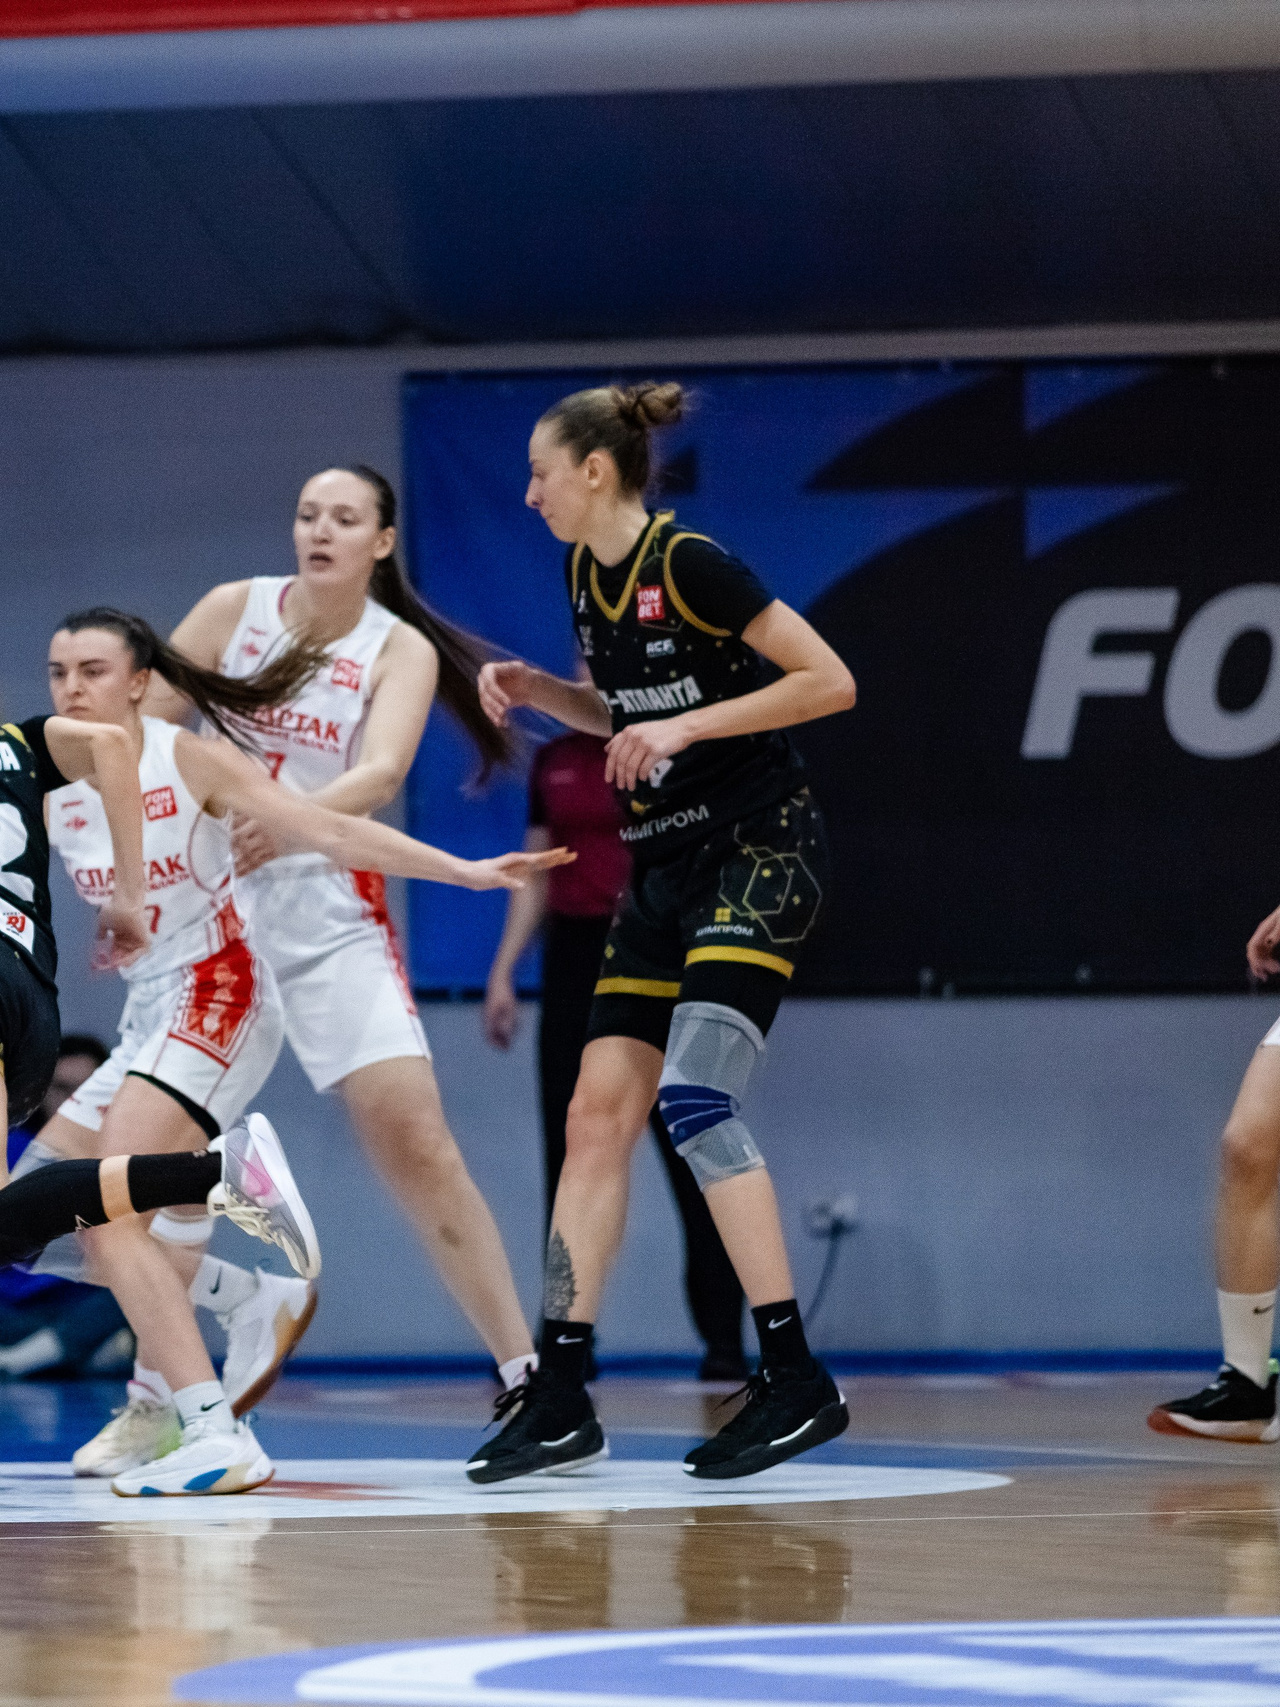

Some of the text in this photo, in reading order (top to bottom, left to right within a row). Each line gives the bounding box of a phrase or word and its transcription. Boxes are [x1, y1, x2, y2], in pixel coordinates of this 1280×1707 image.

[1020, 584, 1280, 760] FO
[264, 751, 287, 782] 7
[619, 804, 710, 842] ИМПРОМ
[75, 853, 186, 889] СПААК
